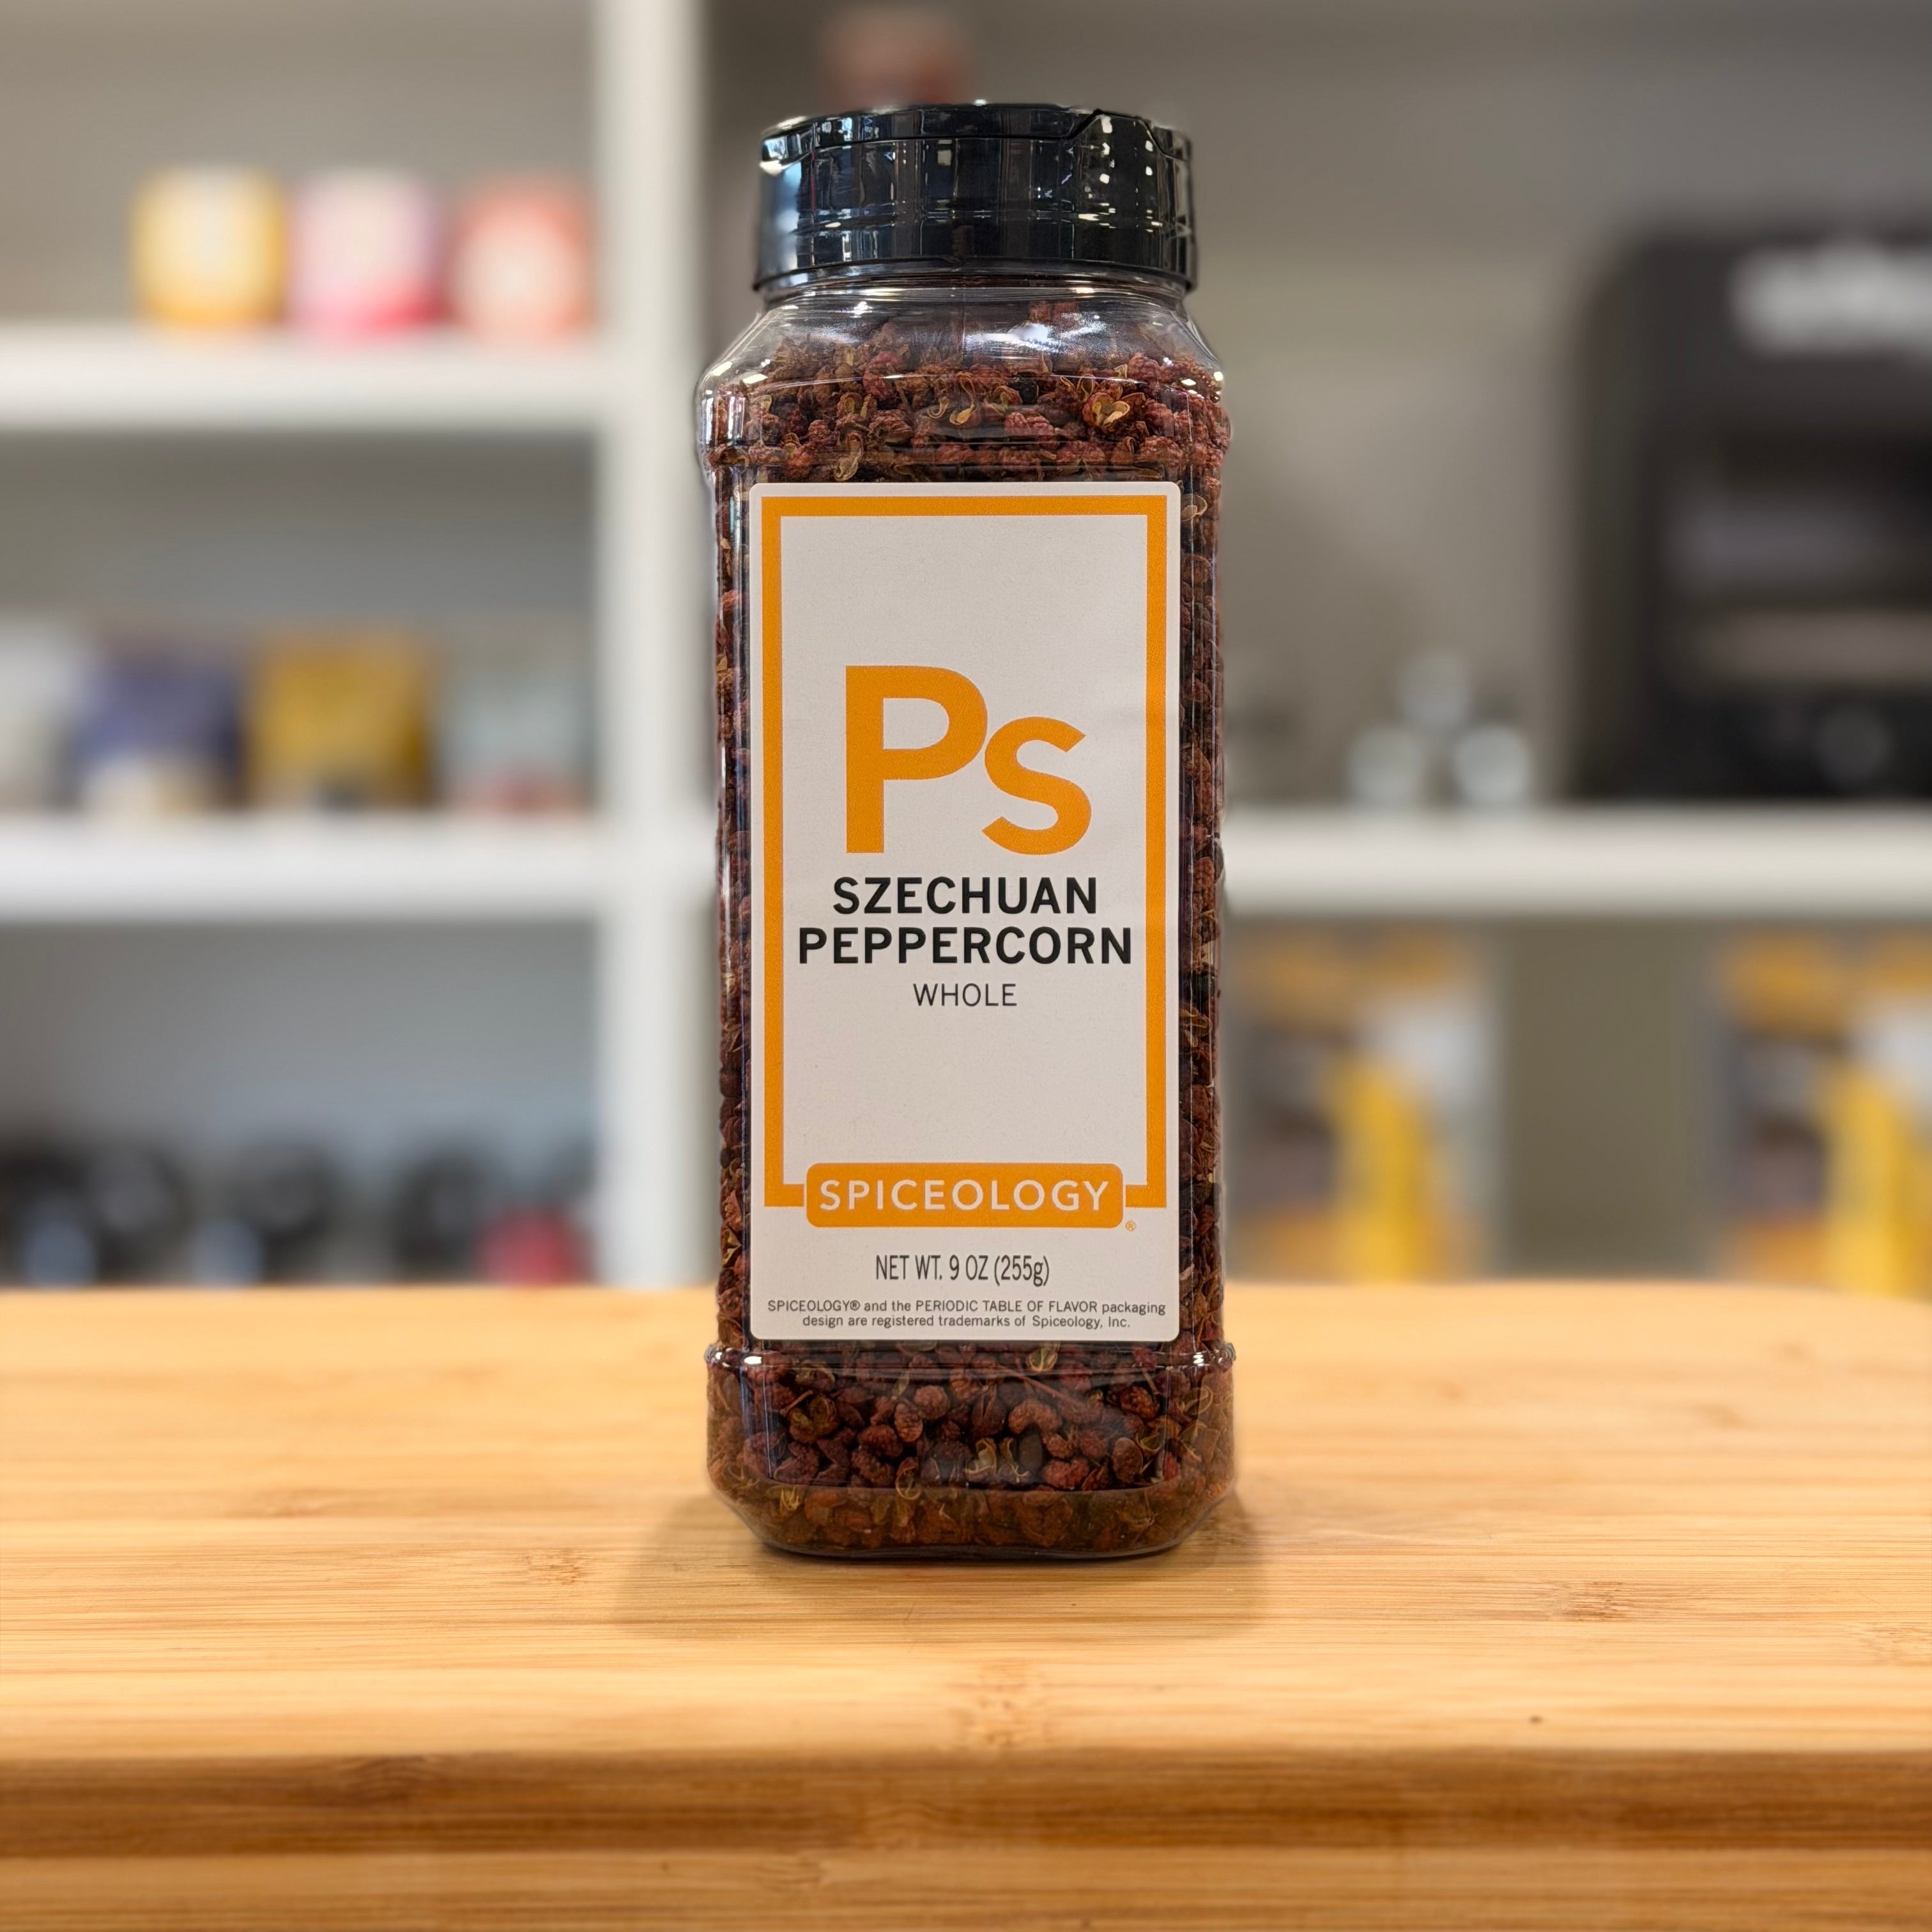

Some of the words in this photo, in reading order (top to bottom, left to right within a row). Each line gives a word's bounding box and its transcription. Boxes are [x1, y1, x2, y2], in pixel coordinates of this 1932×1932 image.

[845, 666, 1091, 855] Ps
[832, 876, 1096, 915] SZECHUAN
[799, 926, 1131, 965] PEPPERCORN
[913, 983, 1017, 1007] WHOLE
[819, 1179, 1108, 1212] SPICEOLOGY
[876, 1255, 910, 1280] NET
[915, 1255, 942, 1280] WT.
[949, 1254, 960, 1280] 9
[965, 1254, 988, 1281] OZ
[994, 1254, 1050, 1287] (255g)
[802, 1315, 843, 1329] design
[848, 1317, 868, 1326] are
[871, 1315, 934, 1329] registered
[939, 1315, 1010, 1326] trademarks
[1014, 1315, 1026, 1327] of
[1032, 1315, 1103, 1330] Spiceology,
[1108, 1315, 1130, 1328] Inc.
[864, 1300, 887, 1312] and
[891, 1300, 911, 1312] the
[916, 1300, 978, 1312] PERIODIC
[982, 1300, 1022, 1312] TABLE
[1027, 1300, 1044, 1312] OF
[1048, 1300, 1098, 1313] FLAVOR
[1102, 1301, 1166, 1316] packaging
